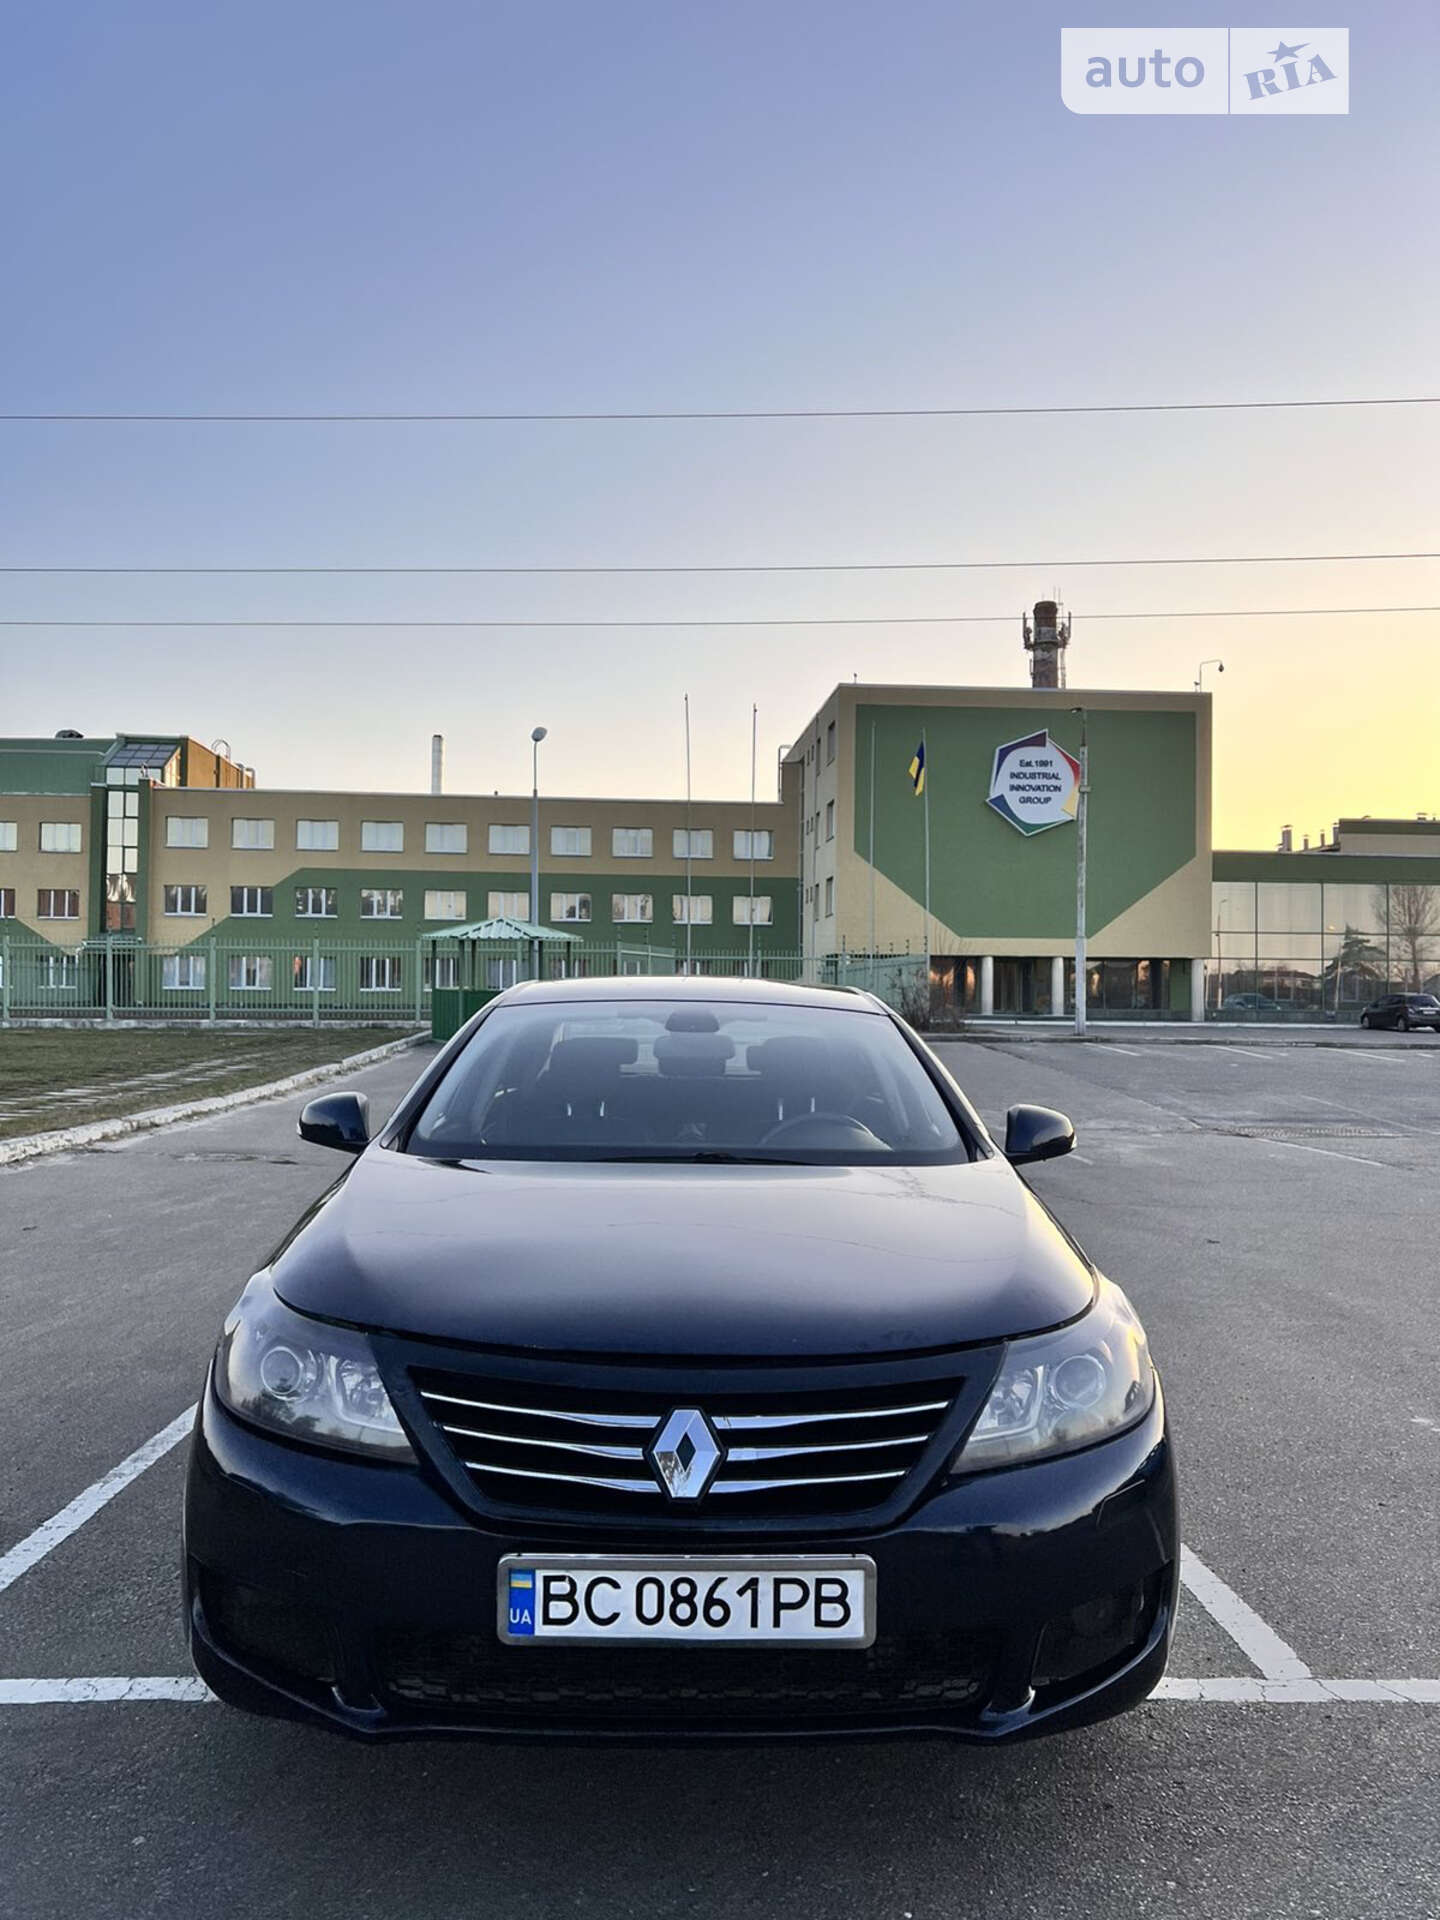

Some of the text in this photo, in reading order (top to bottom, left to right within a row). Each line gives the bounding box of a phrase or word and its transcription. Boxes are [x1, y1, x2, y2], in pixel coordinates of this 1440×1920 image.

[1010, 772, 1061, 780] INDUSTRIAL
[1009, 784, 1061, 792] INNOVATION
[1018, 796, 1051, 804] GROUP
[510, 1609, 532, 1624] UA
